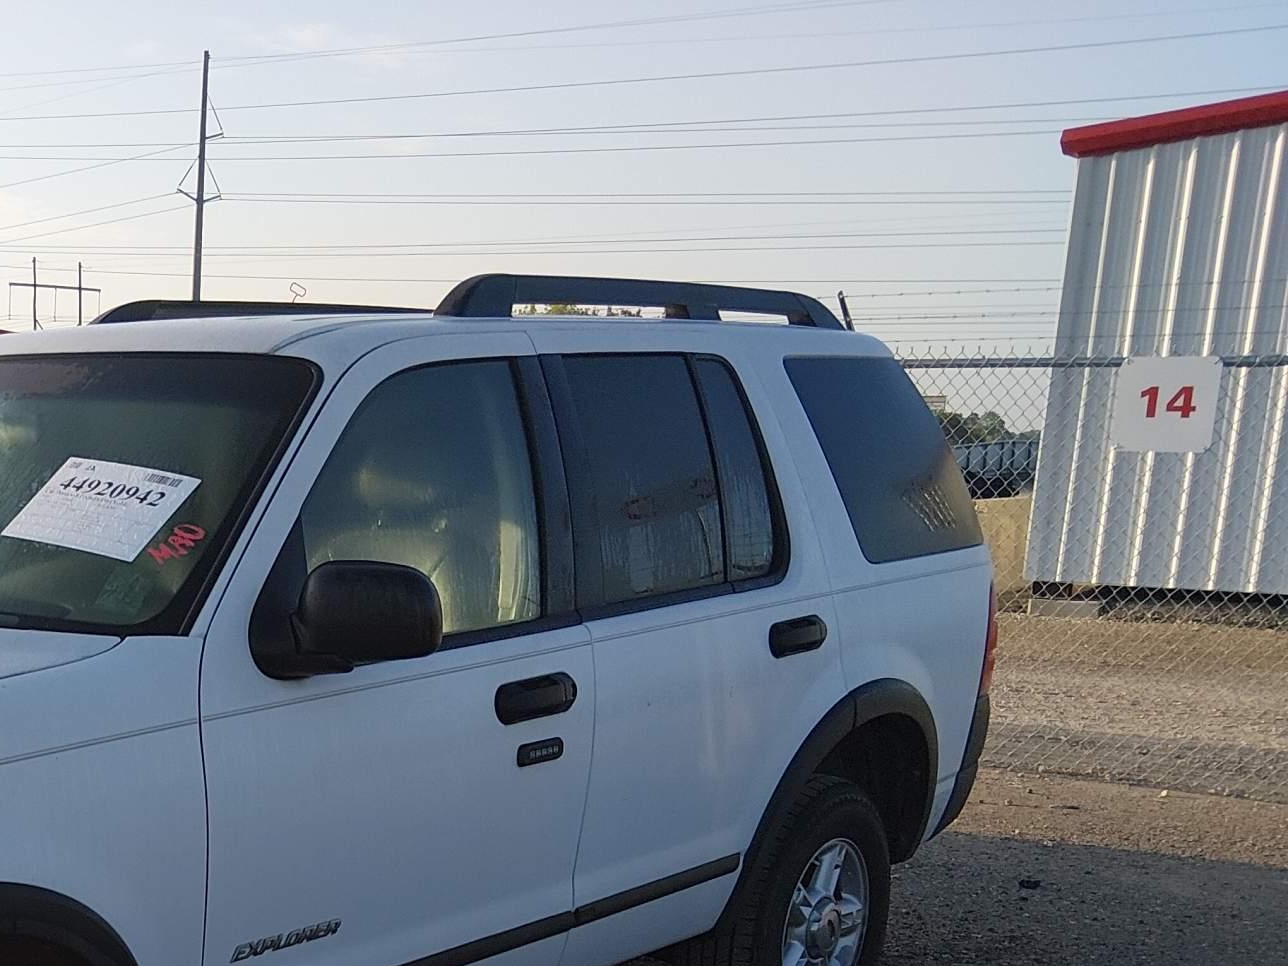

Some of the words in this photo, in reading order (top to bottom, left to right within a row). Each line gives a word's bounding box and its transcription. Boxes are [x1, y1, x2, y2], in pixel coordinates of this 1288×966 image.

[1140, 385, 1197, 419] 14
[60, 476, 167, 507] 44920942
[230, 918, 342, 964] EXPLORER
